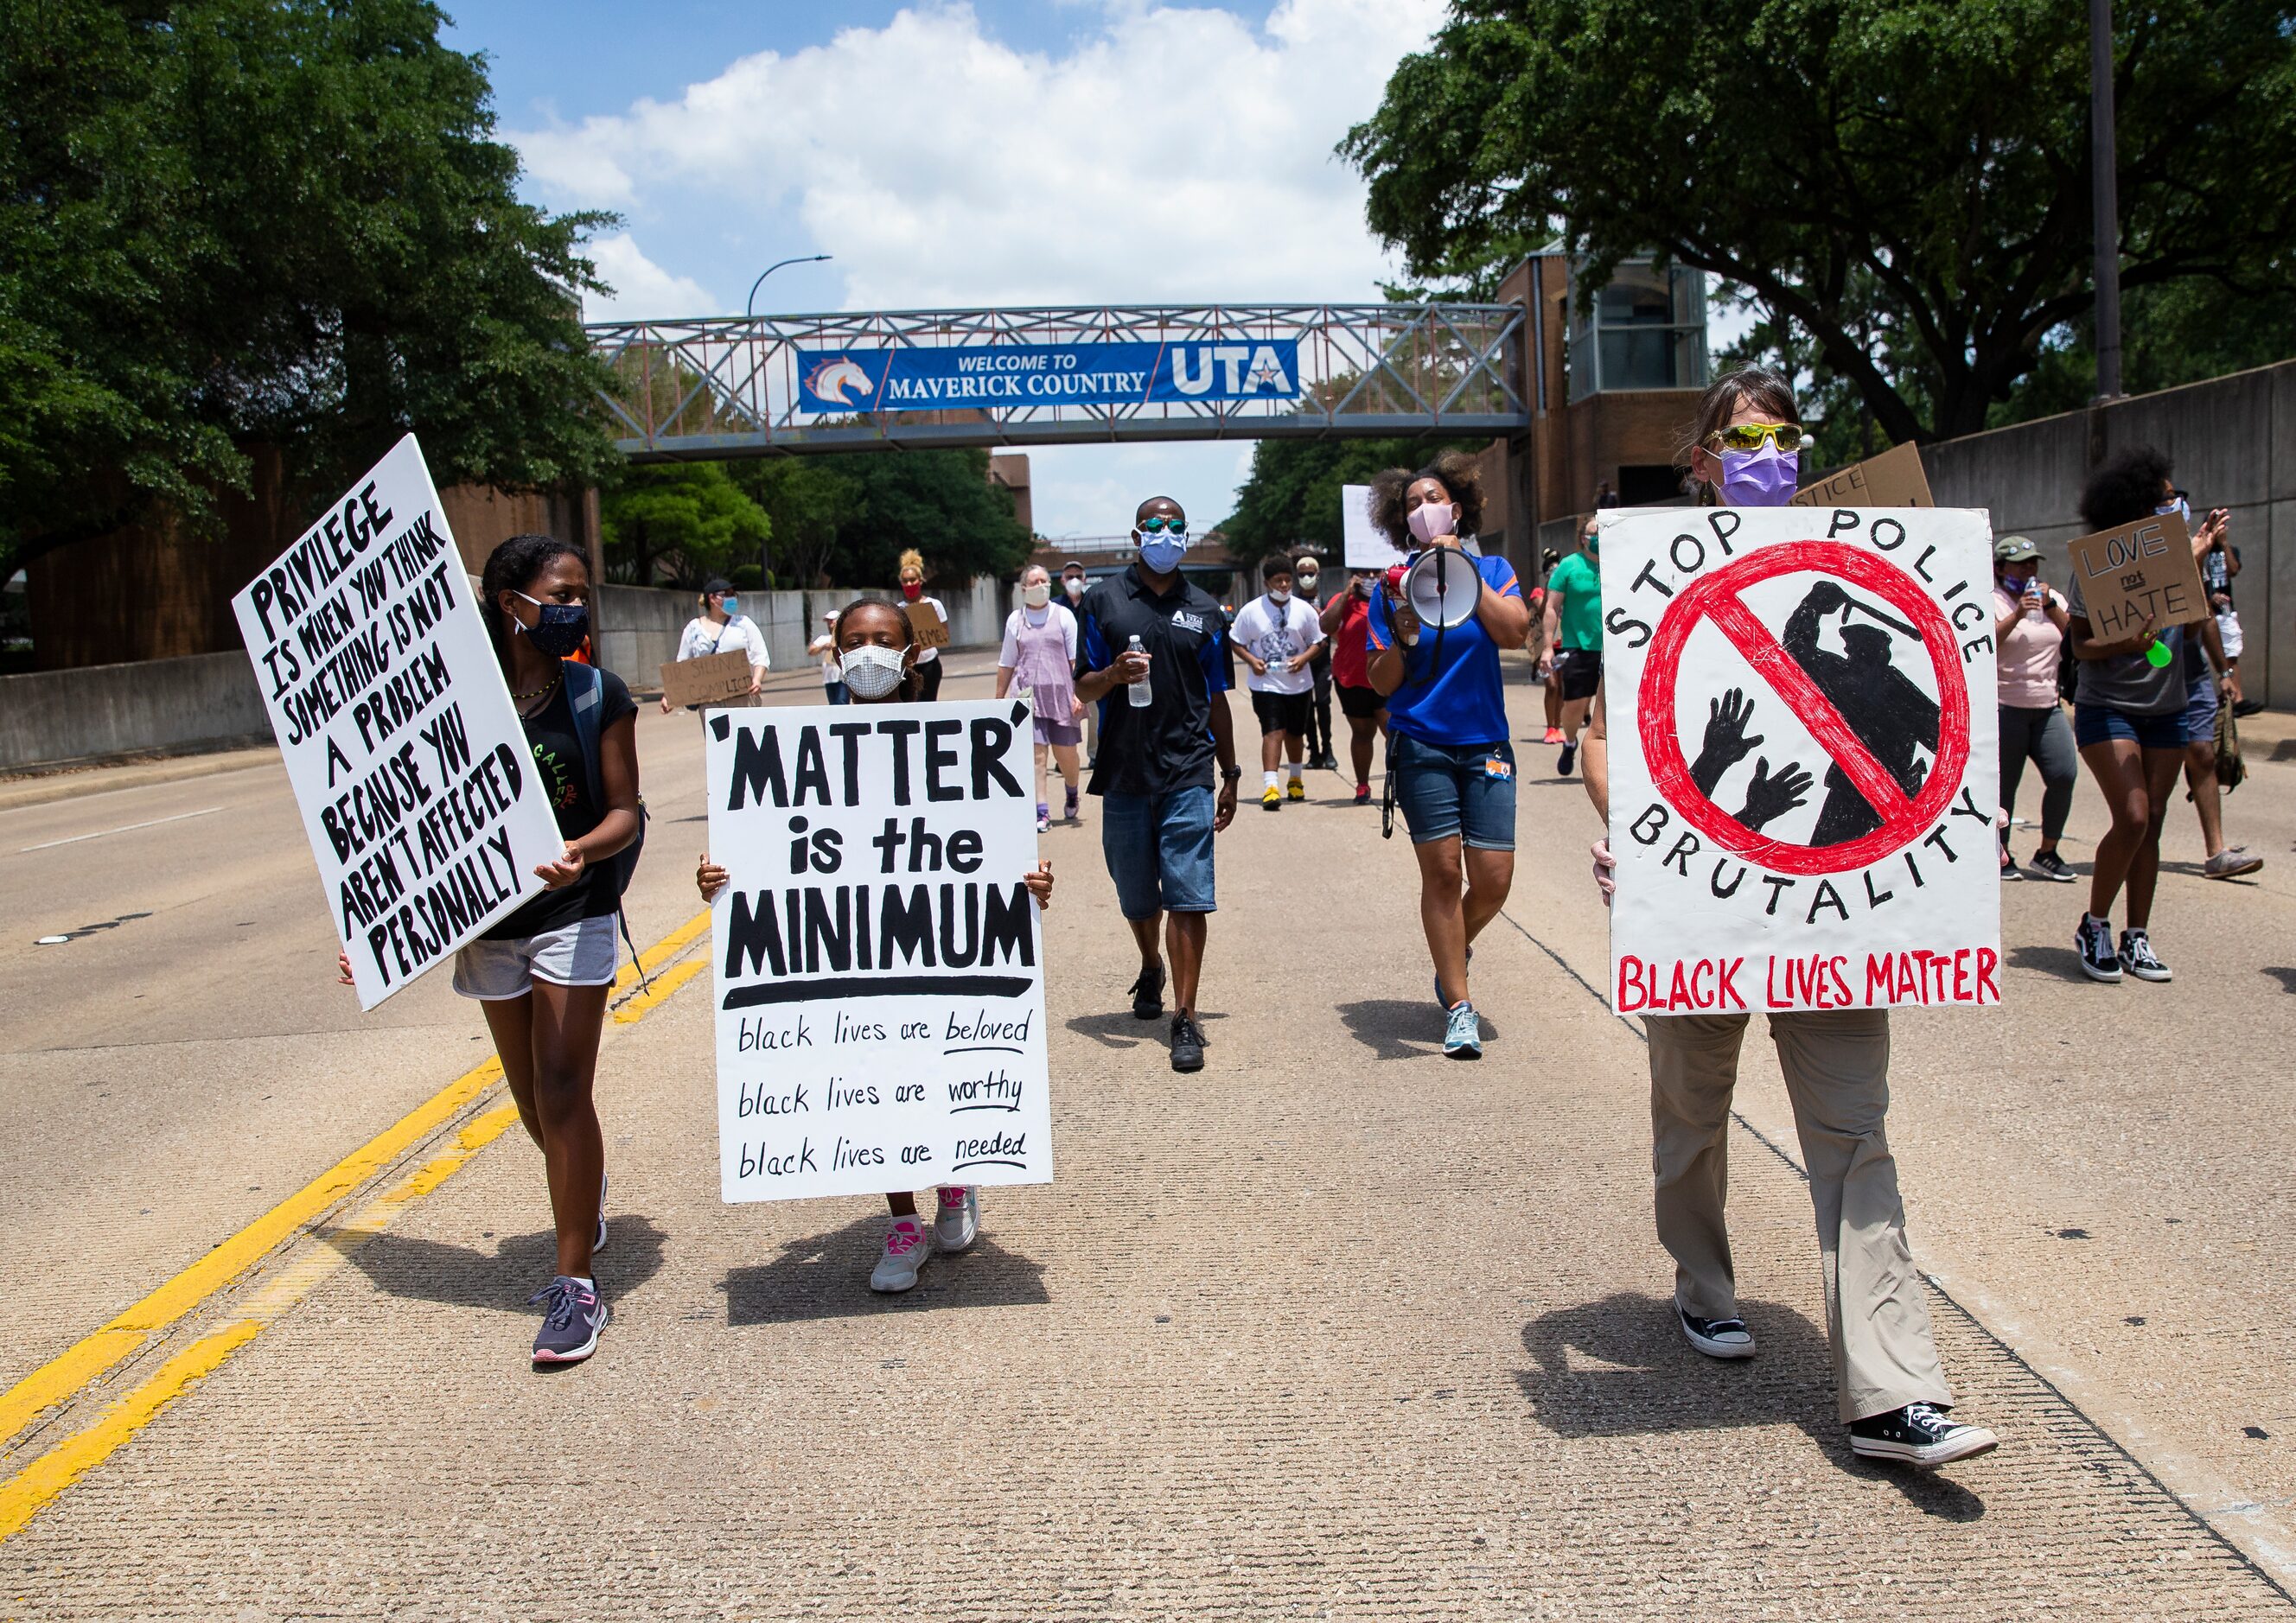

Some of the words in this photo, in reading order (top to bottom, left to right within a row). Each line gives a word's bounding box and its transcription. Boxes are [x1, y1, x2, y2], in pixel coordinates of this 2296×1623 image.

[889, 375, 1023, 400] MAVERICK
[1026, 371, 1146, 396] COUNTRY
[958, 354, 1049, 372] WELCOME
[1053, 354, 1077, 370] TO
[1171, 346, 1292, 395] UTA
[251, 480, 393, 643] PRIVILEGE
[2081, 523, 2168, 579] LOVE
[2120, 570, 2145, 586] not
[263, 645, 302, 703] IS
[300, 606, 351, 666] WHEN
[349, 557, 386, 616] YOU
[381, 509, 447, 589] THINK
[1604, 510, 1741, 649] STOP
[1827, 509, 1993, 665] POLICE
[2097, 583, 2189, 636] HATE
[283, 626, 391, 746] SOMETHING
[386, 610, 411, 656] IS
[411, 560, 456, 640] NOT
[327, 735, 353, 788] A
[352, 641, 451, 748] PROBLEM
[320, 741, 430, 866] BECAUSE
[424, 700, 470, 788] YOU
[533, 743, 568, 807] CALLED
[340, 822, 423, 941] AREN'T
[421, 742, 523, 878] AFFECTED
[788, 815, 843, 874] is
[873, 817, 983, 874] the
[1629, 785, 1993, 925] BRUTALITY
[367, 825, 523, 987] PERSONALLY
[724, 882, 1036, 978] MINIMUM
[1618, 953, 1749, 1013] BLACK
[1767, 953, 1853, 1009] LIVES
[1866, 947, 1999, 1005] MATTER
[738, 1017, 813, 1053] black
[834, 1011, 886, 1043] lives
[900, 1023, 931, 1041] are
[945, 1009, 1032, 1043] beloved
[738, 1081, 809, 1117] black
[827, 1078, 880, 1110] lives
[896, 1084, 925, 1102] are
[948, 1070, 1023, 1111] worthy
[739, 1142, 817, 1179] black
[833, 1138, 884, 1172] lives
[901, 1146, 932, 1163] are
[955, 1132, 1026, 1158] needed
